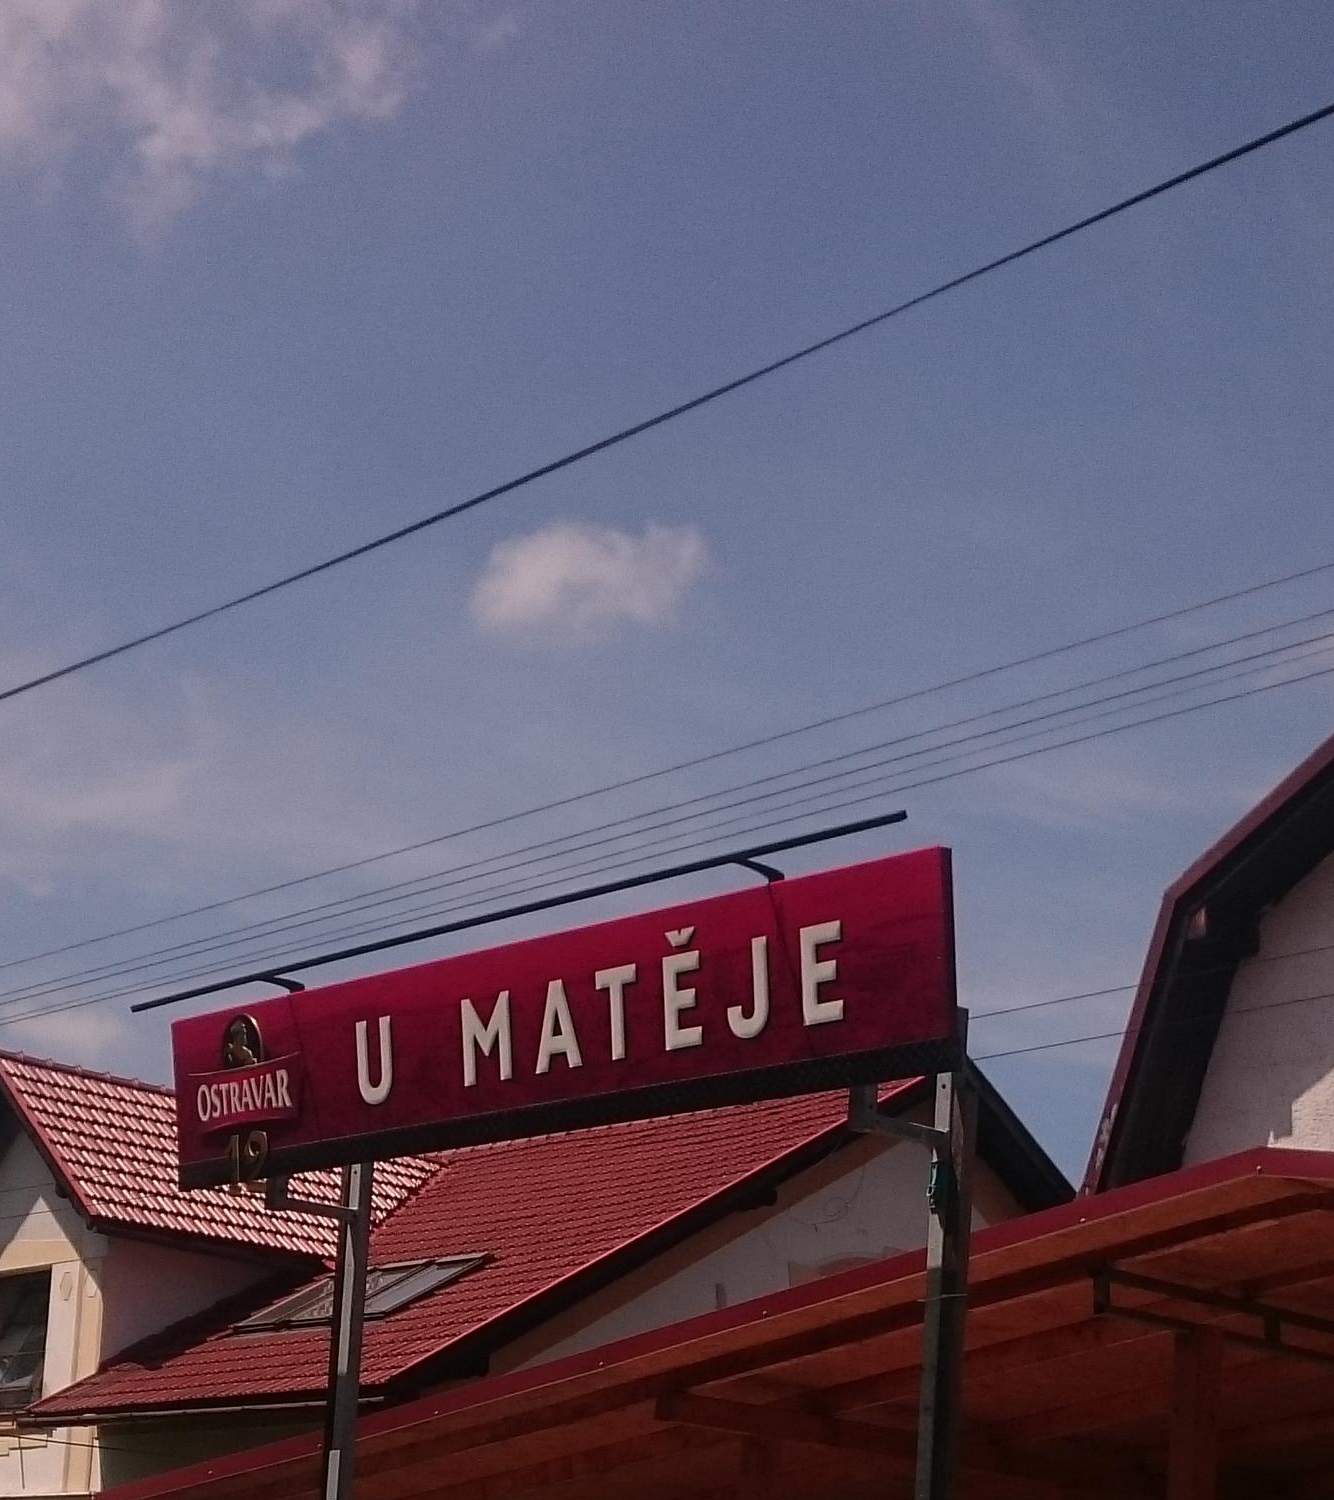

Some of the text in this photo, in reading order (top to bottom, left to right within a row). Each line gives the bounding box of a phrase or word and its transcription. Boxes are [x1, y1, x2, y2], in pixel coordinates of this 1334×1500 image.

[355, 920, 845, 1105] U MATĚJE
[197, 1069, 292, 1123] OSTRAVAR
